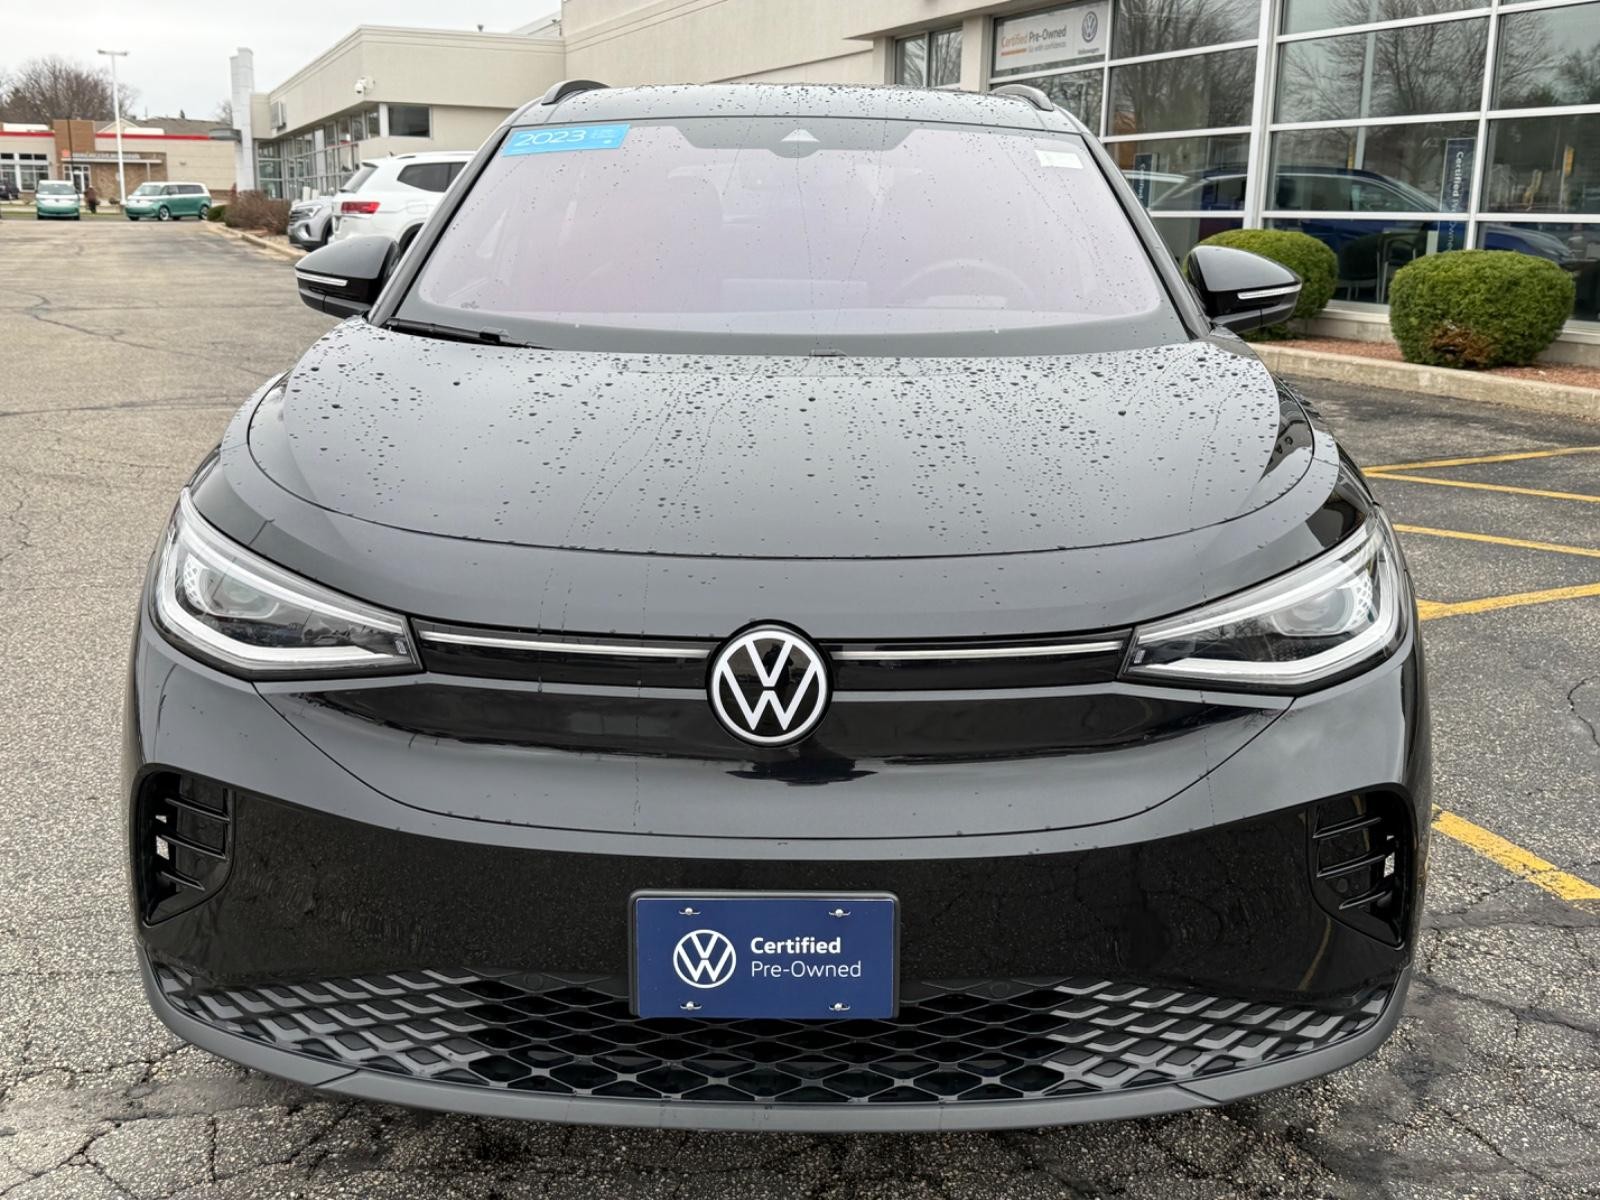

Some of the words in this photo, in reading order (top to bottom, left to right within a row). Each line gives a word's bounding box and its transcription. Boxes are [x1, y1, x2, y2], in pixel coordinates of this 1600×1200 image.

[1001, 32, 1028, 48] Certified
[1029, 25, 1067, 41] Pre-Owned
[514, 129, 587, 147] 2023
[1452, 151, 1464, 197] Certified
[750, 936, 841, 955] Certified
[751, 960, 862, 978] Pre-Owned
